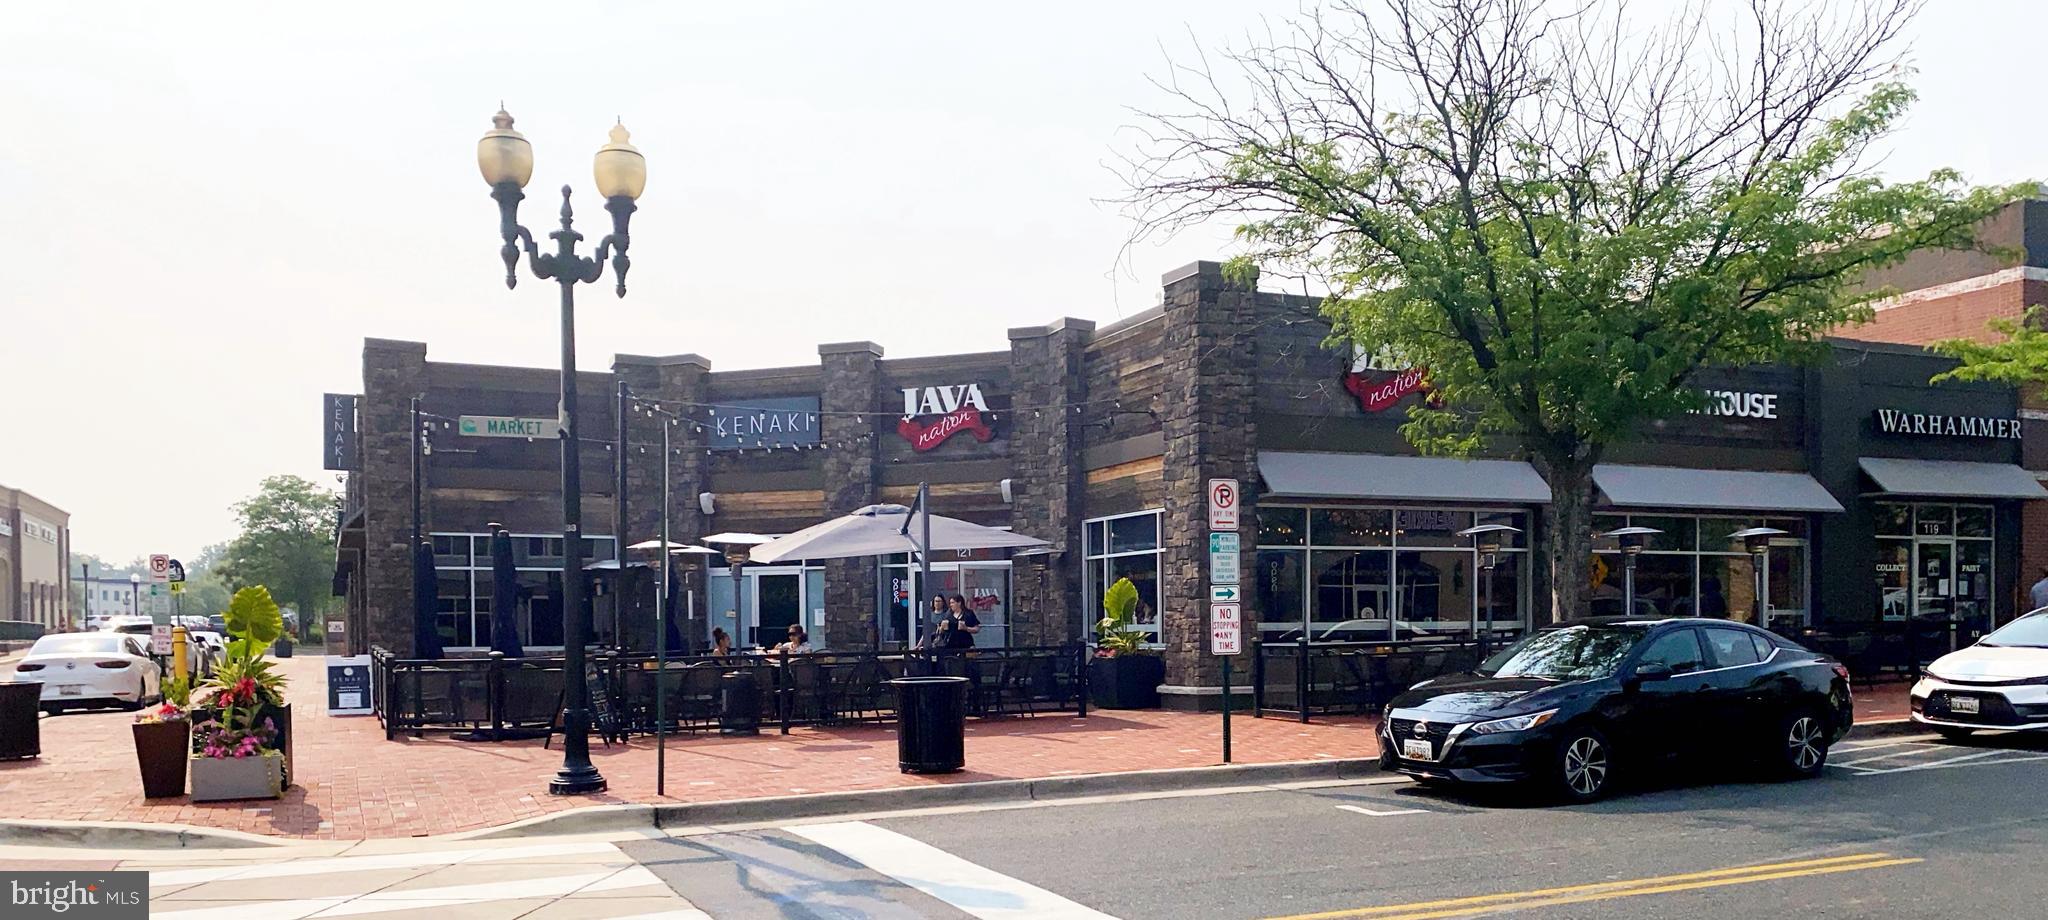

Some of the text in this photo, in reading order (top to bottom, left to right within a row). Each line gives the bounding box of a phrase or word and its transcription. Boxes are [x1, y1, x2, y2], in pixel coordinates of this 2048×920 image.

[1370, 371, 1422, 405] nation
[901, 383, 989, 420] JAVA
[487, 420, 543, 435] MARKET
[716, 412, 809, 435] KENAKI
[919, 412, 971, 446] nation
[1878, 408, 2022, 439] WARHAMMER
[334, 396, 345, 468] KENAKI
[1924, 524, 1939, 535] 119
[957, 548, 972, 558] 121
[1876, 563, 1906, 572] COLLECT
[1962, 564, 1981, 572] PAINT
[1219, 608, 1232, 619] NO
[1213, 621, 1239, 630] STOPPING
[1220, 631, 1233, 640] ANY
[1219, 641, 1234, 650] TIME
